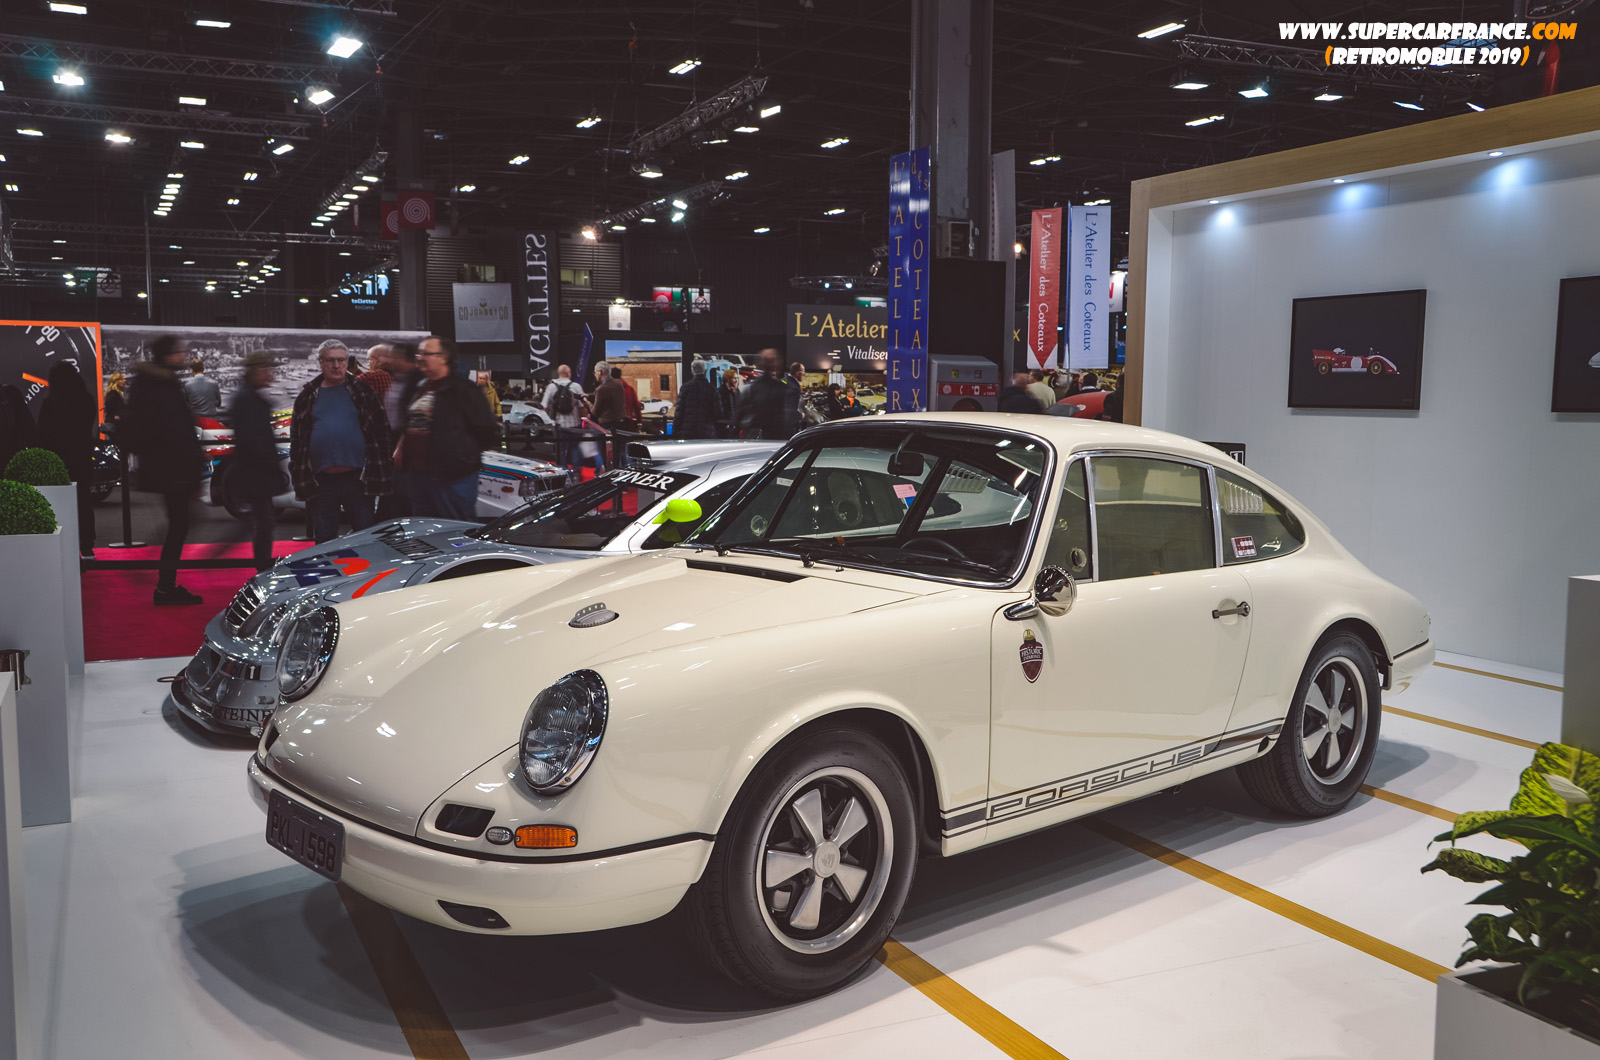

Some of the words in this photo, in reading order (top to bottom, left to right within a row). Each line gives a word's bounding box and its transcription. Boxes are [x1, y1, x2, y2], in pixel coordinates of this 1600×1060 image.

[1039, 214, 1052, 270] L'Atelier
[1085, 211, 1098, 269] L'Atelier
[1039, 276, 1050, 297] des
[1084, 275, 1097, 295] des
[794, 312, 888, 339] L'Atelier
[1037, 303, 1049, 352] Coteaux
[1083, 301, 1096, 351] Coteaux
[990, 745, 1204, 818] PORSCHE
